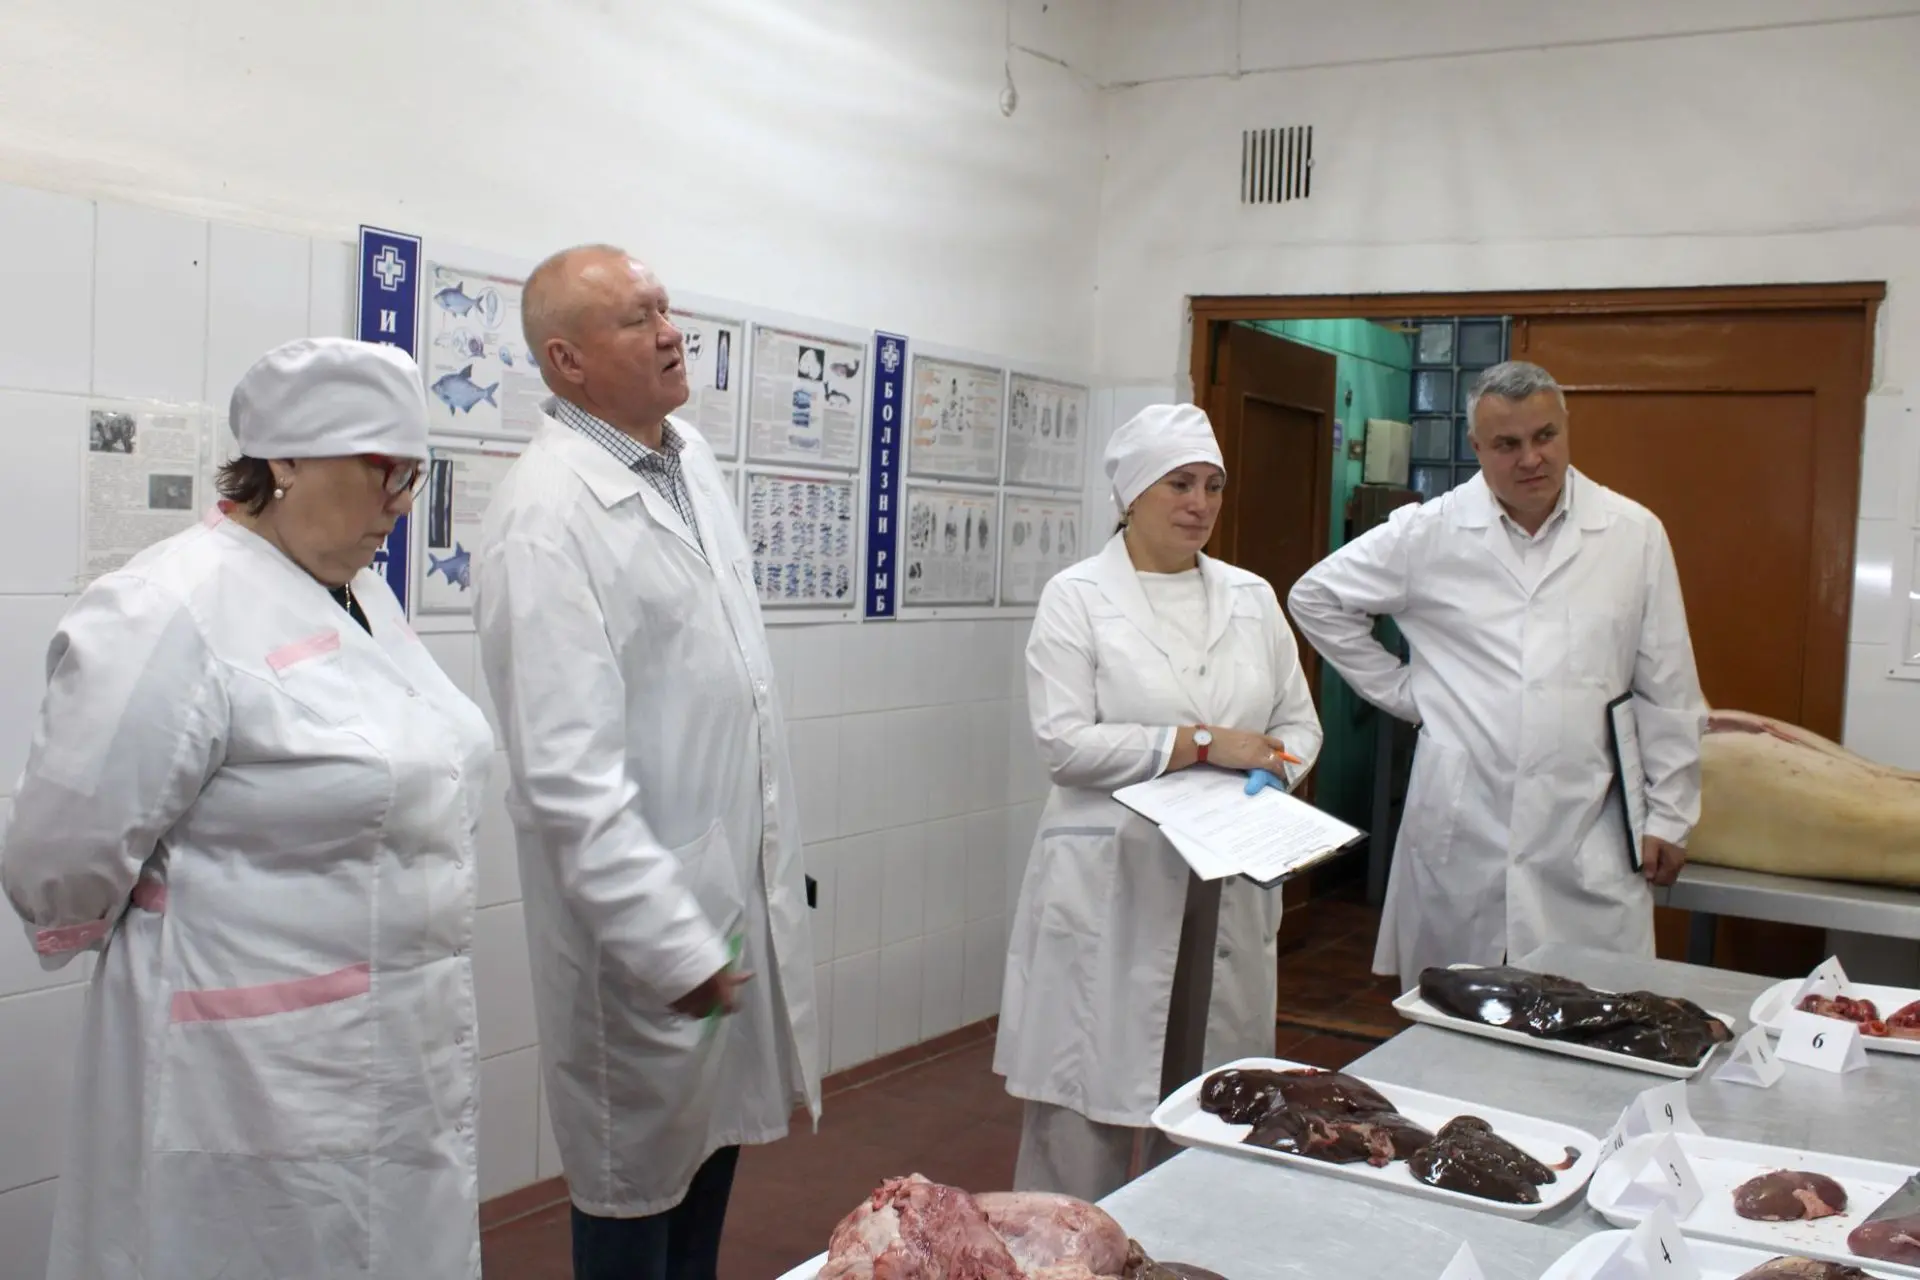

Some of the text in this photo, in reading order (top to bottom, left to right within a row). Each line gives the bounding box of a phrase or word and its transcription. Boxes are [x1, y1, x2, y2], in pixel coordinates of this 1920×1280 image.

[875, 382, 894, 612] БОЛЕЗНИ РЫБ
[1812, 1032, 1827, 1049] 6
[1665, 1103, 1674, 1126] 9
[1660, 1237, 1672, 1264] 4
